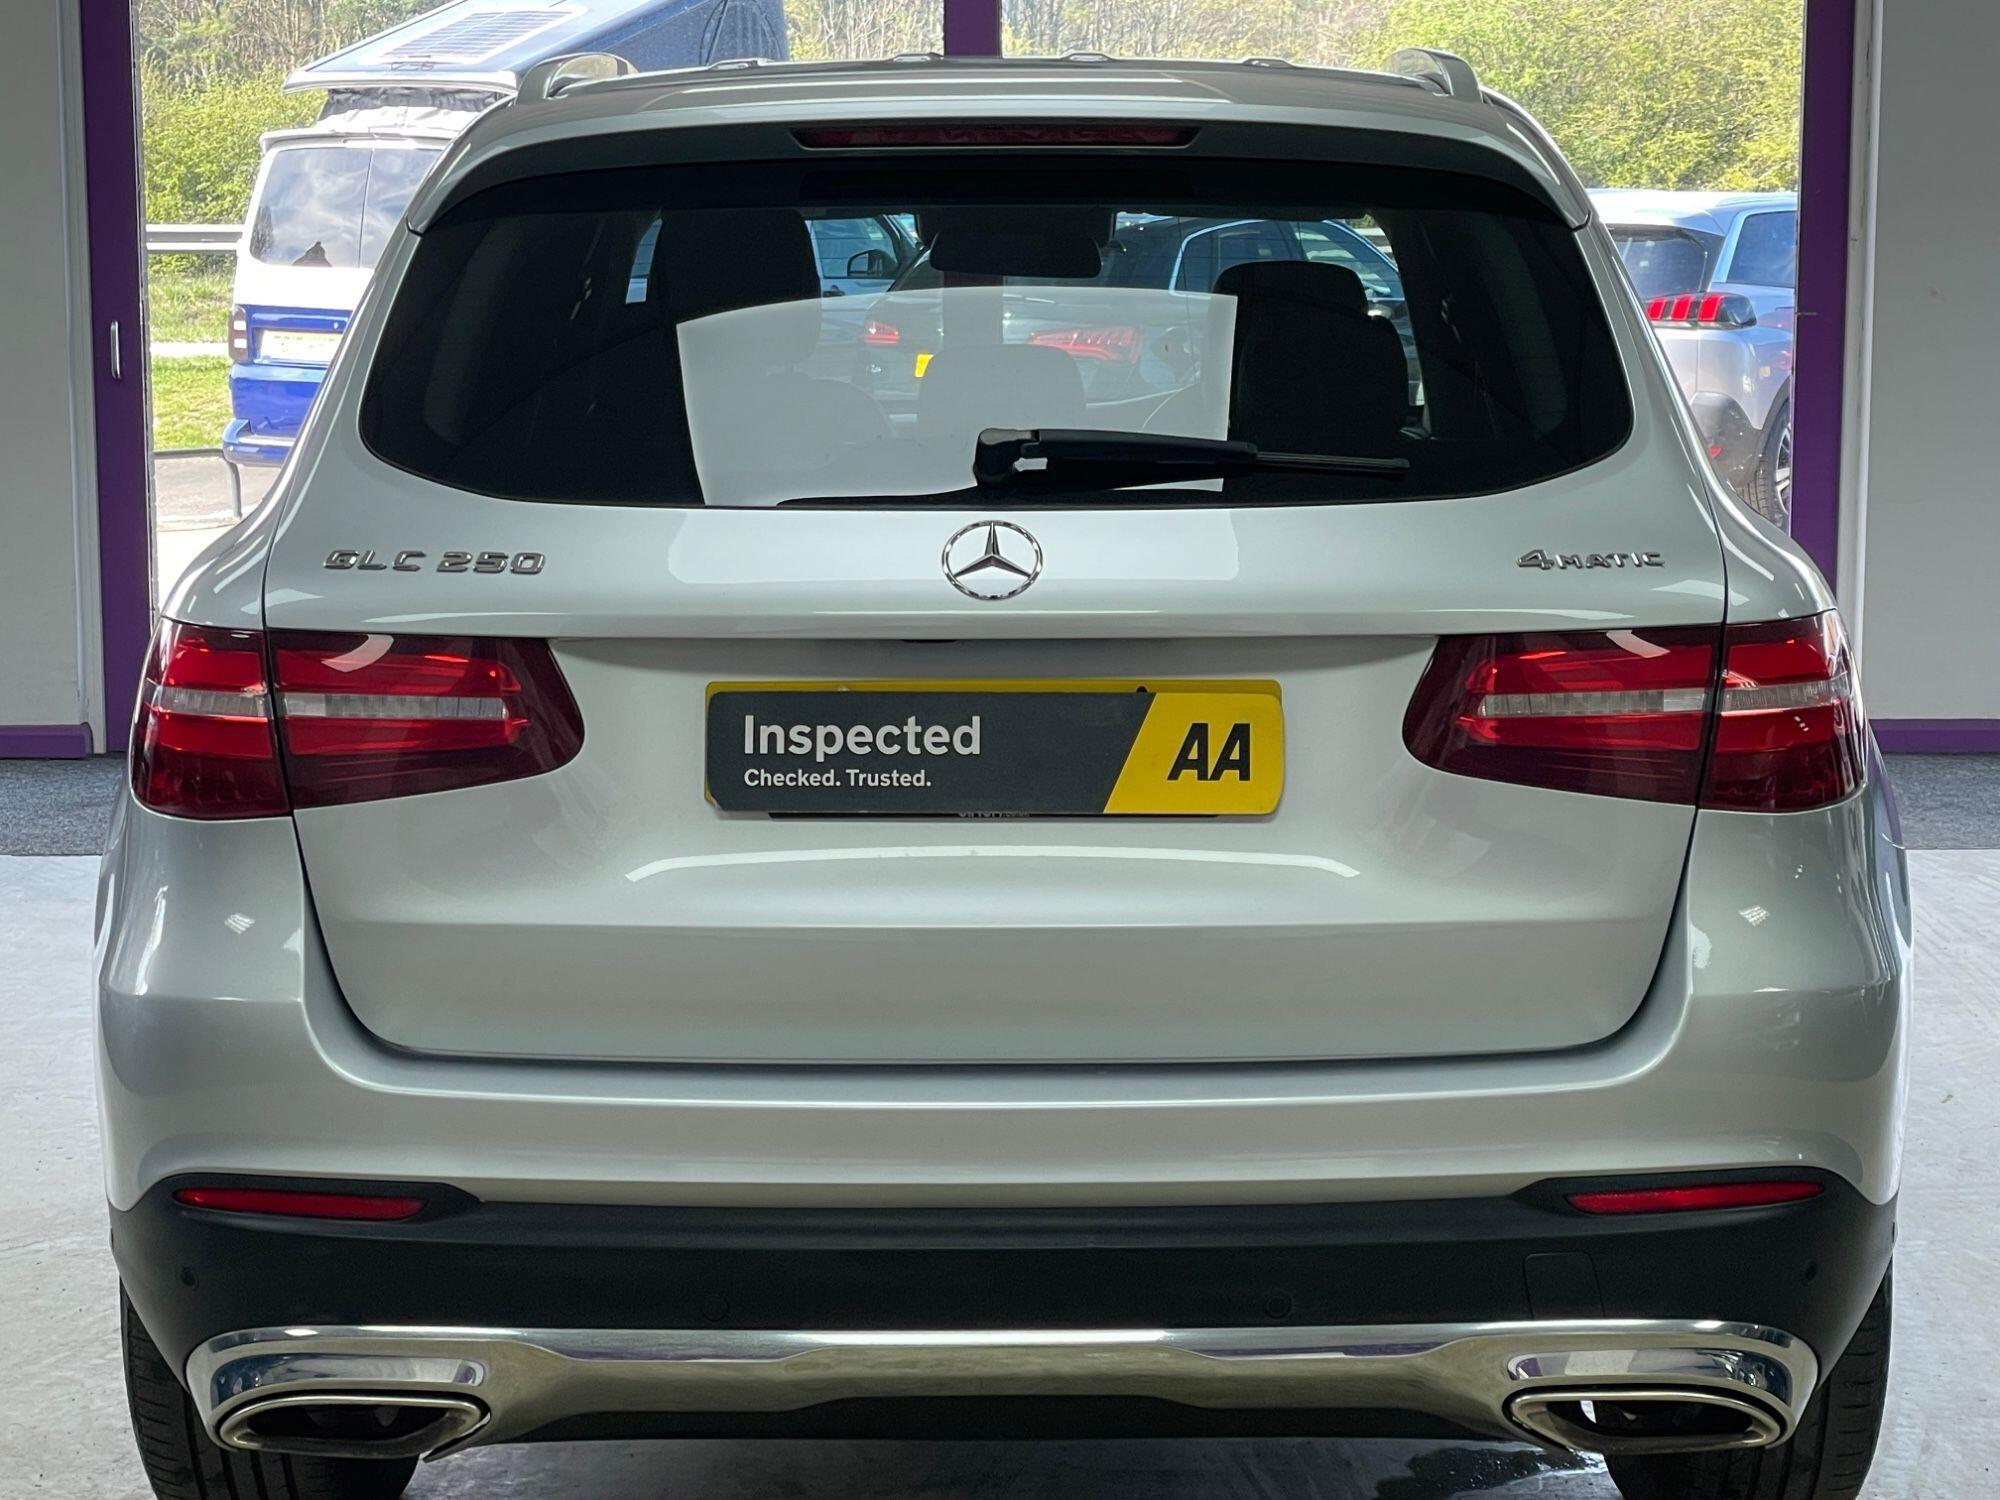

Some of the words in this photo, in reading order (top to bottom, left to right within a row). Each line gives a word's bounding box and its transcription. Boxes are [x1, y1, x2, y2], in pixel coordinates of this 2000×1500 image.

[323, 549, 427, 572] GLC
[436, 551, 546, 575] 250
[1517, 549, 1665, 570] 4MATIC
[744, 714, 981, 762] Inspected
[1167, 722, 1251, 782] AA
[743, 768, 841, 787] Checked.
[846, 768, 932, 787] Trusted.
